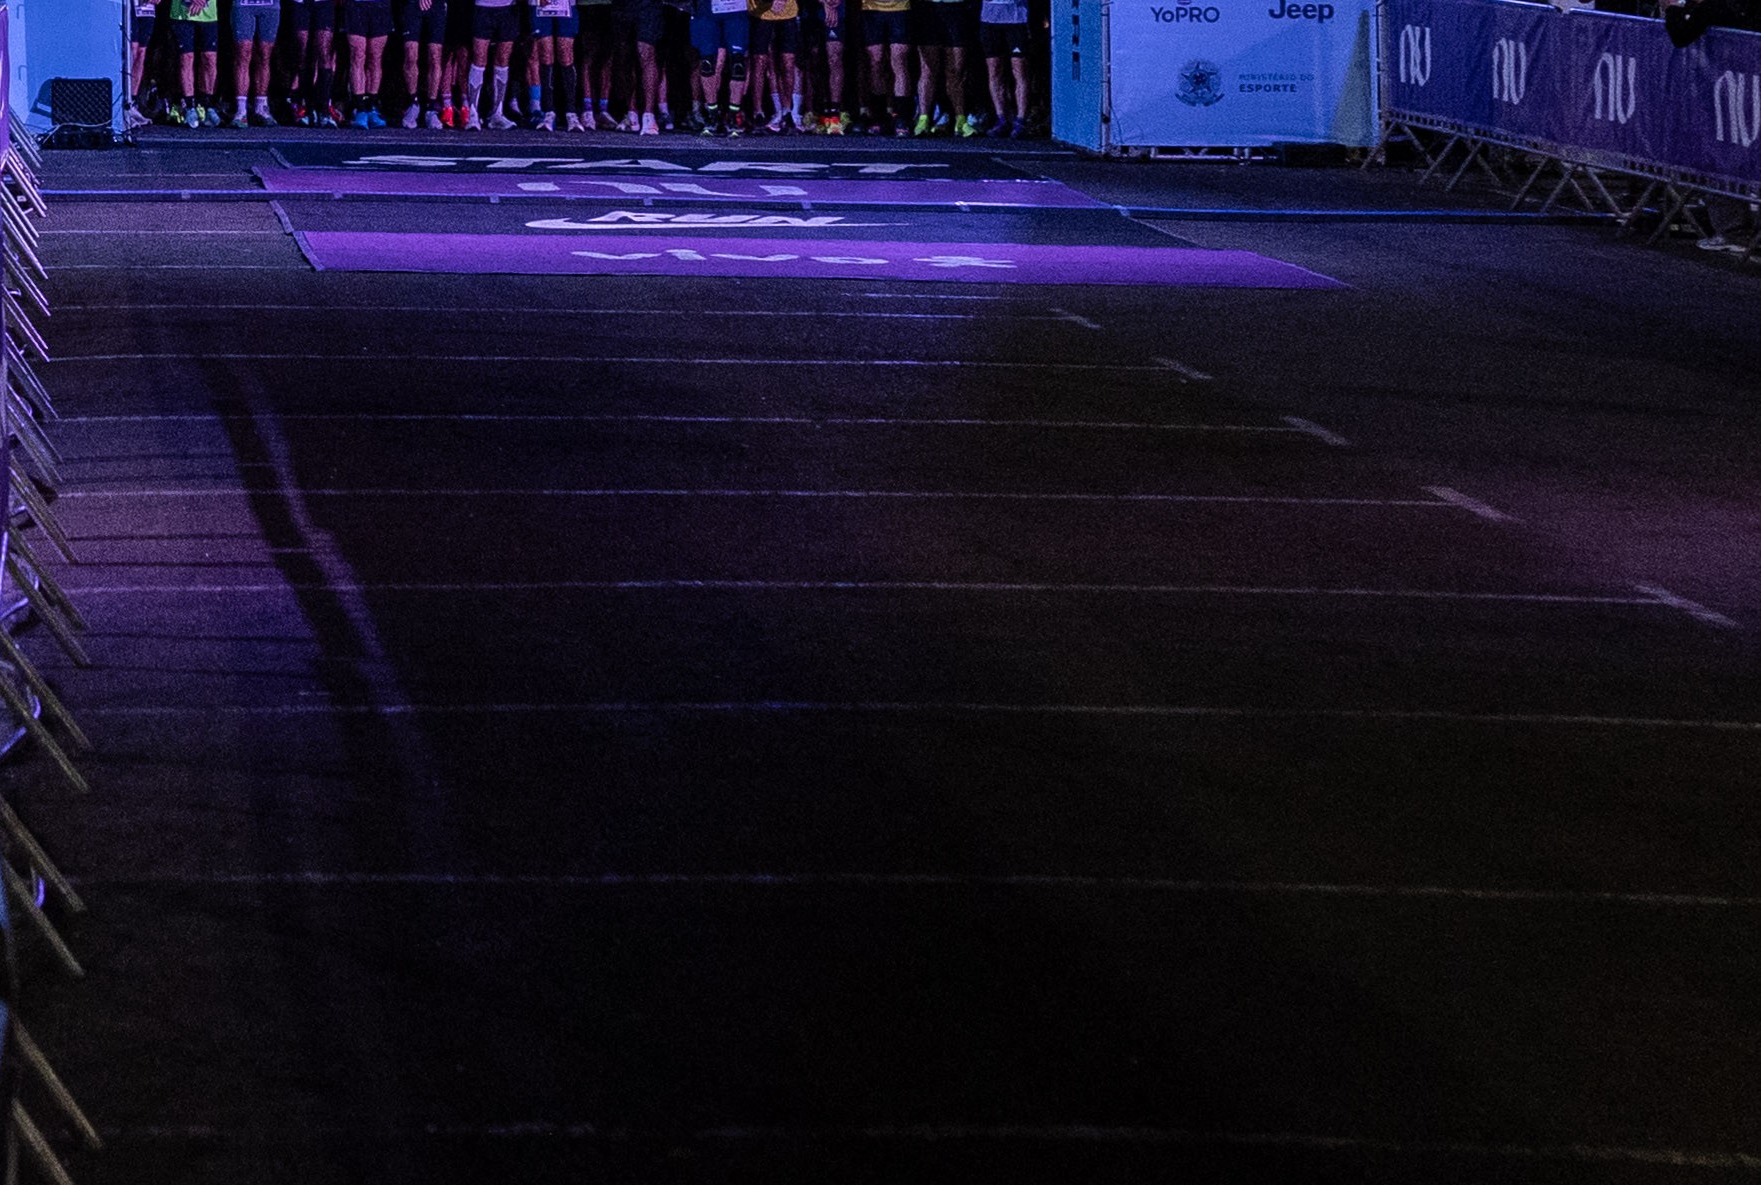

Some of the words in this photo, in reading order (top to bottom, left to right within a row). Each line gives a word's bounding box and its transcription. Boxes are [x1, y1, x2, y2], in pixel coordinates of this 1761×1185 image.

[1150, 6, 1220, 23] YoPRO
[1239, 84, 1296, 92] ESPORTE
[342, 154, 949, 174] START
